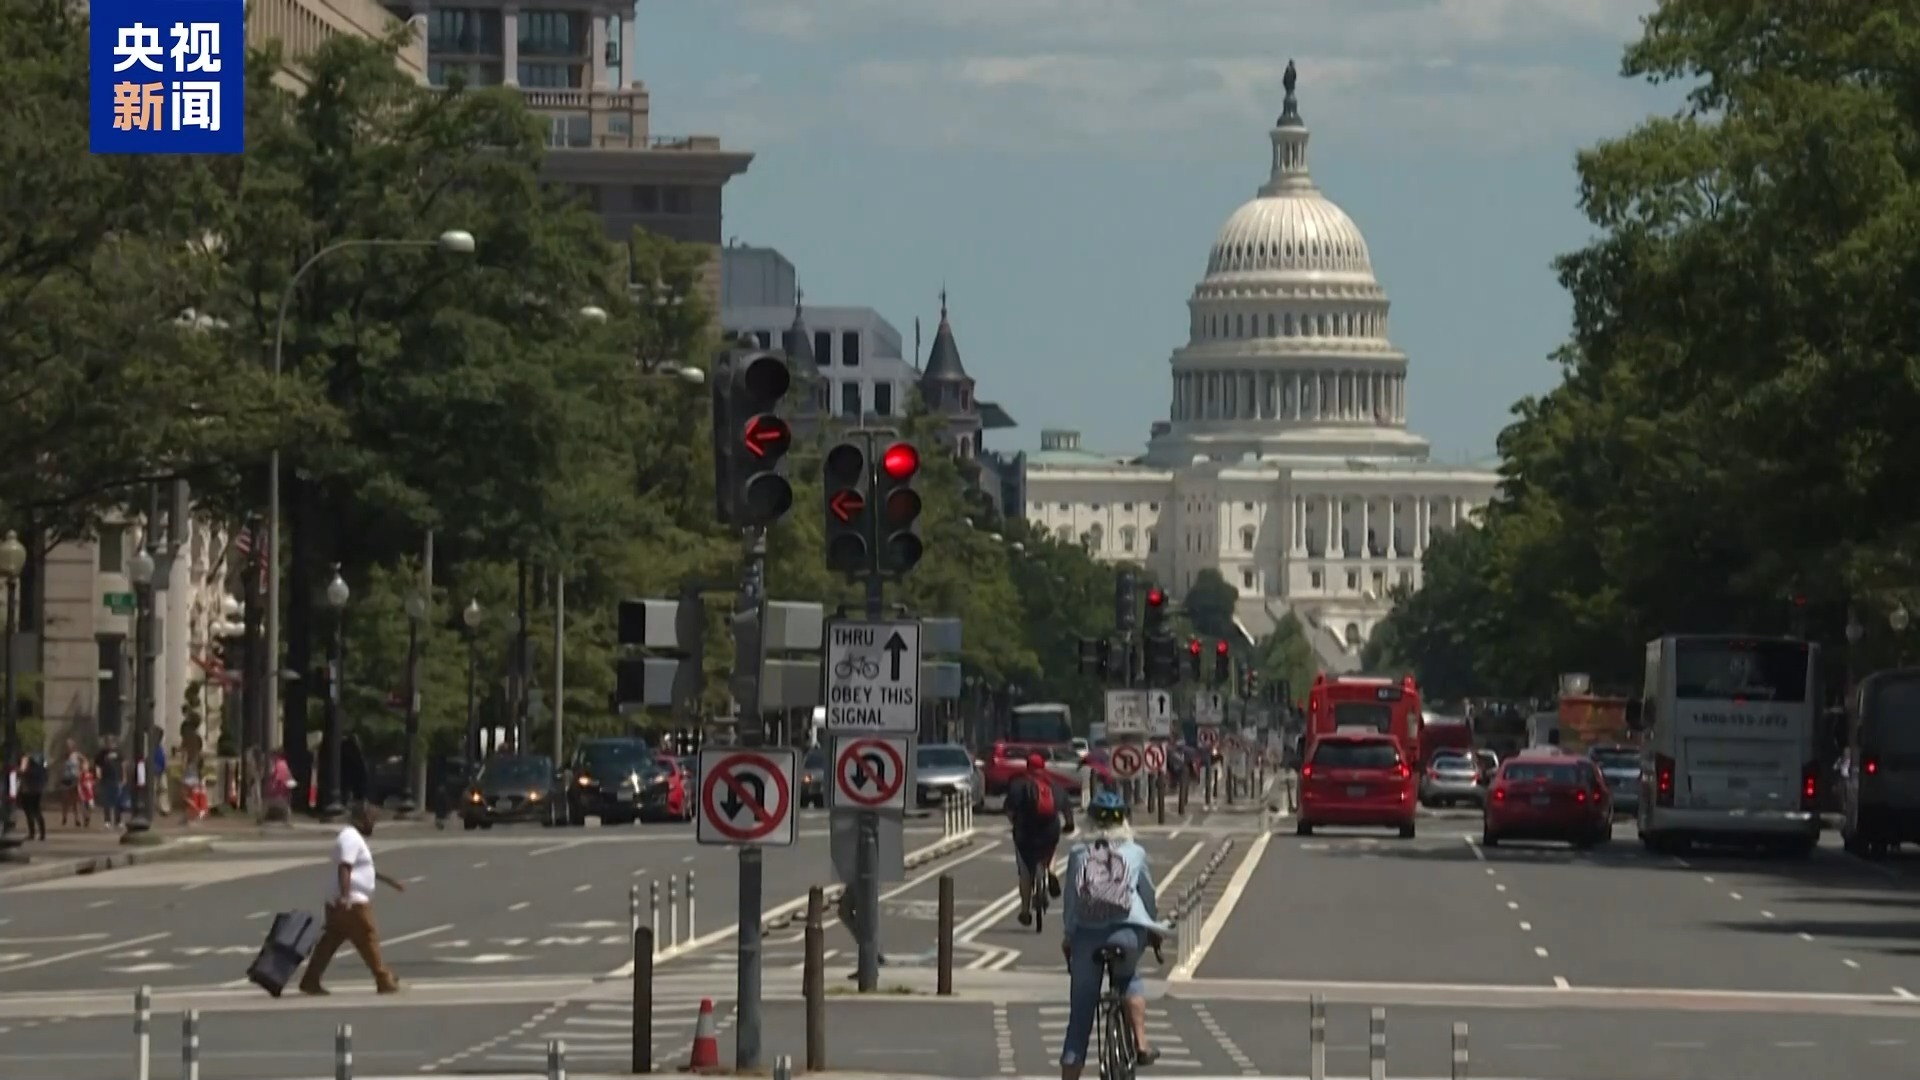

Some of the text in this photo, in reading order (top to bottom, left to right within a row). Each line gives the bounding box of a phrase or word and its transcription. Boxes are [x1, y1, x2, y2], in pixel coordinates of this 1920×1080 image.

[834, 628, 875, 647] THRU
[831, 685, 914, 706] OBEY THIS
[831, 707, 886, 726] SIGNAL
